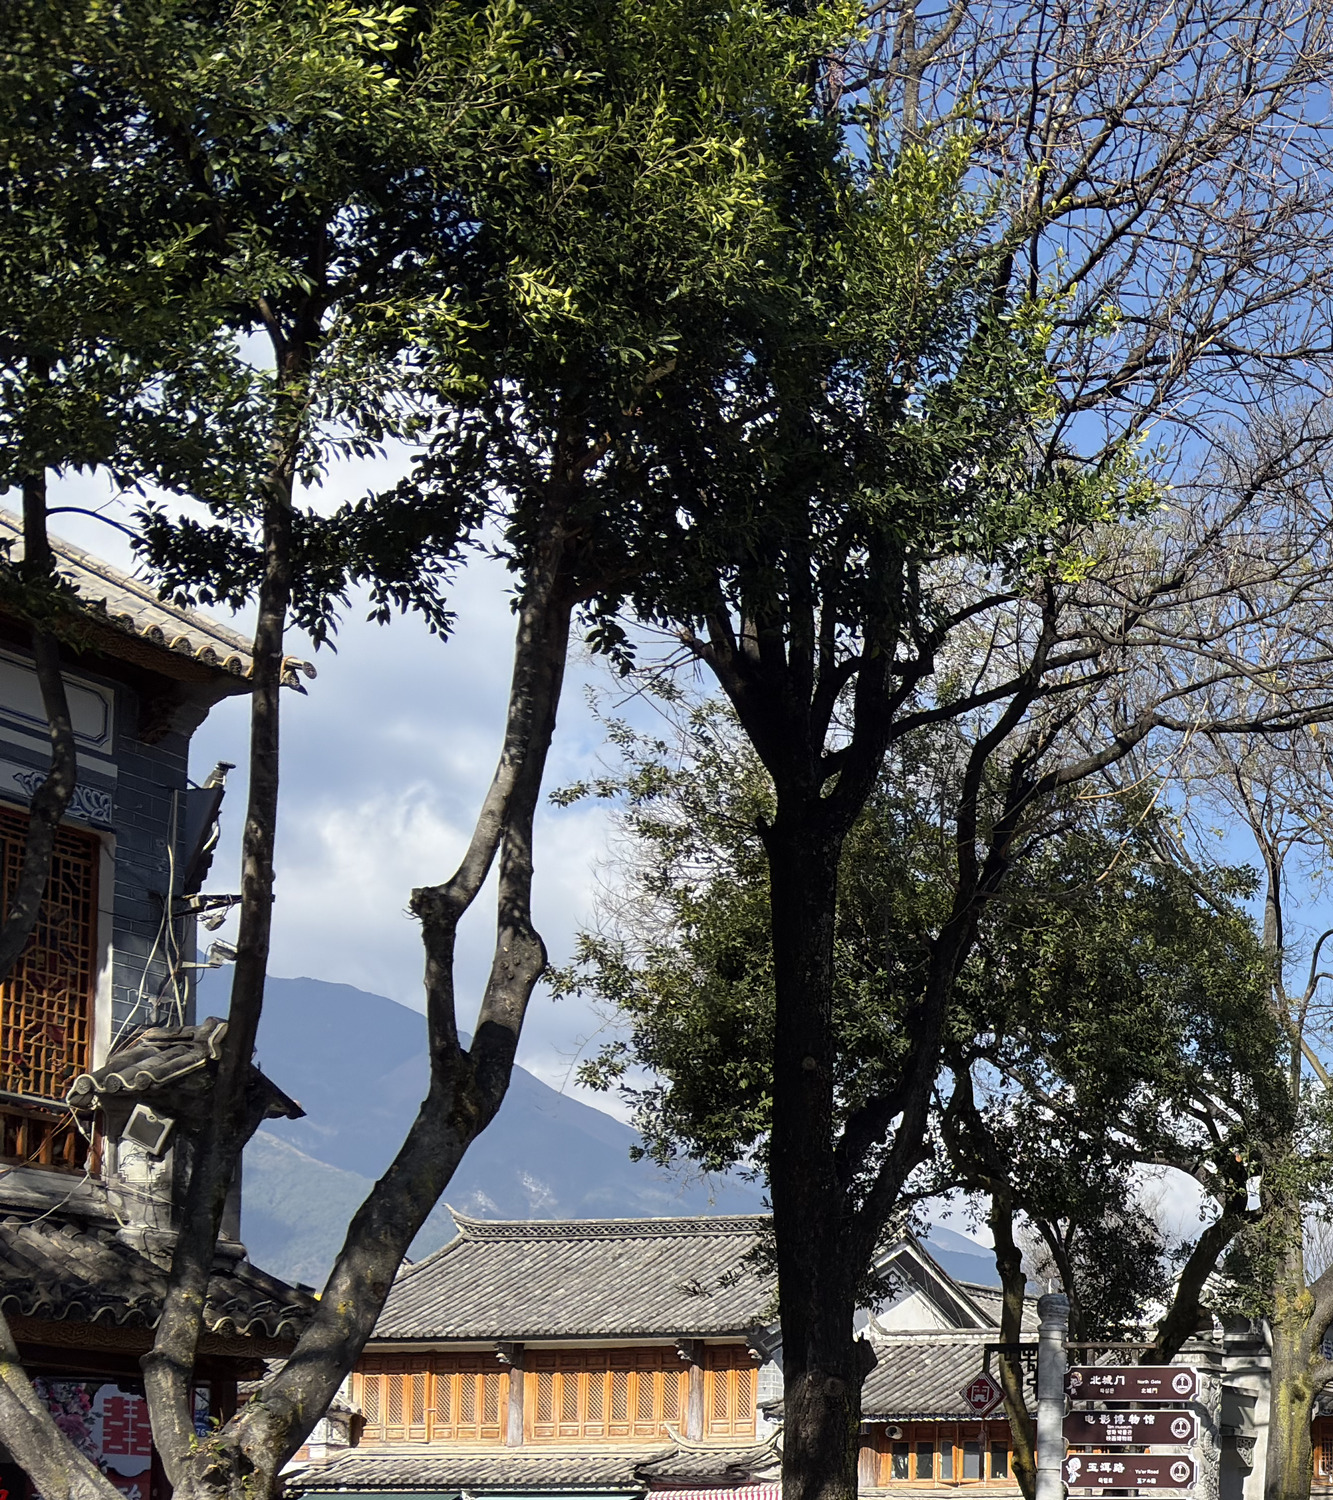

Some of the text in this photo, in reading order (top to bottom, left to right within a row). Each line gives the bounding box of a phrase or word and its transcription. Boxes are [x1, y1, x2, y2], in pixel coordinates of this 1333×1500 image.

[1090, 1375, 1125, 1385] 北城门
[1085, 1414, 1155, 1425] 电影博物馆
[1087, 1462, 1125, 1473] 玉洱路
